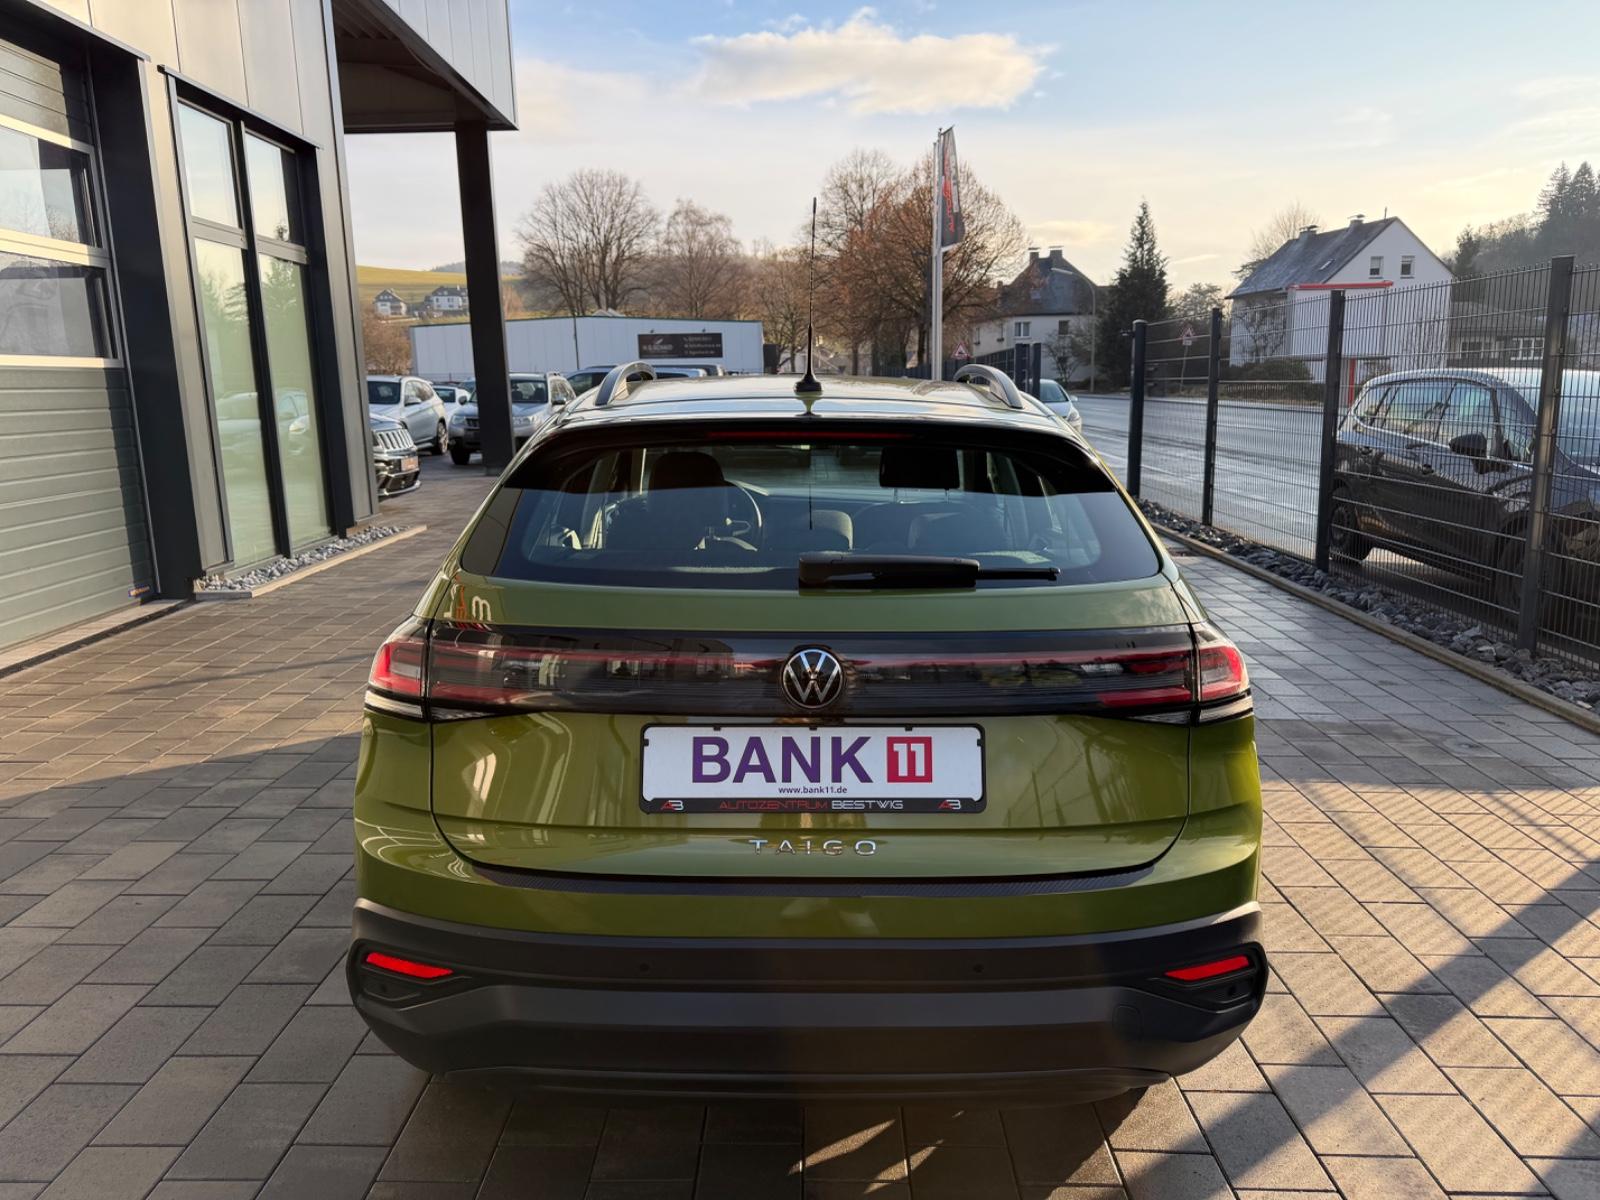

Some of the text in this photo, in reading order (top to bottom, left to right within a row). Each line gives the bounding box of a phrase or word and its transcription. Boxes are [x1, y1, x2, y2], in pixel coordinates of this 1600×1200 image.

[692, 736, 929, 783] BANK 11
[778, 785, 848, 795] www.bank11.de
[719, 799, 828, 810] AUTOZENTRUM
[831, 799, 904, 810] BESTWIG
[748, 839, 878, 856] TAIGO
